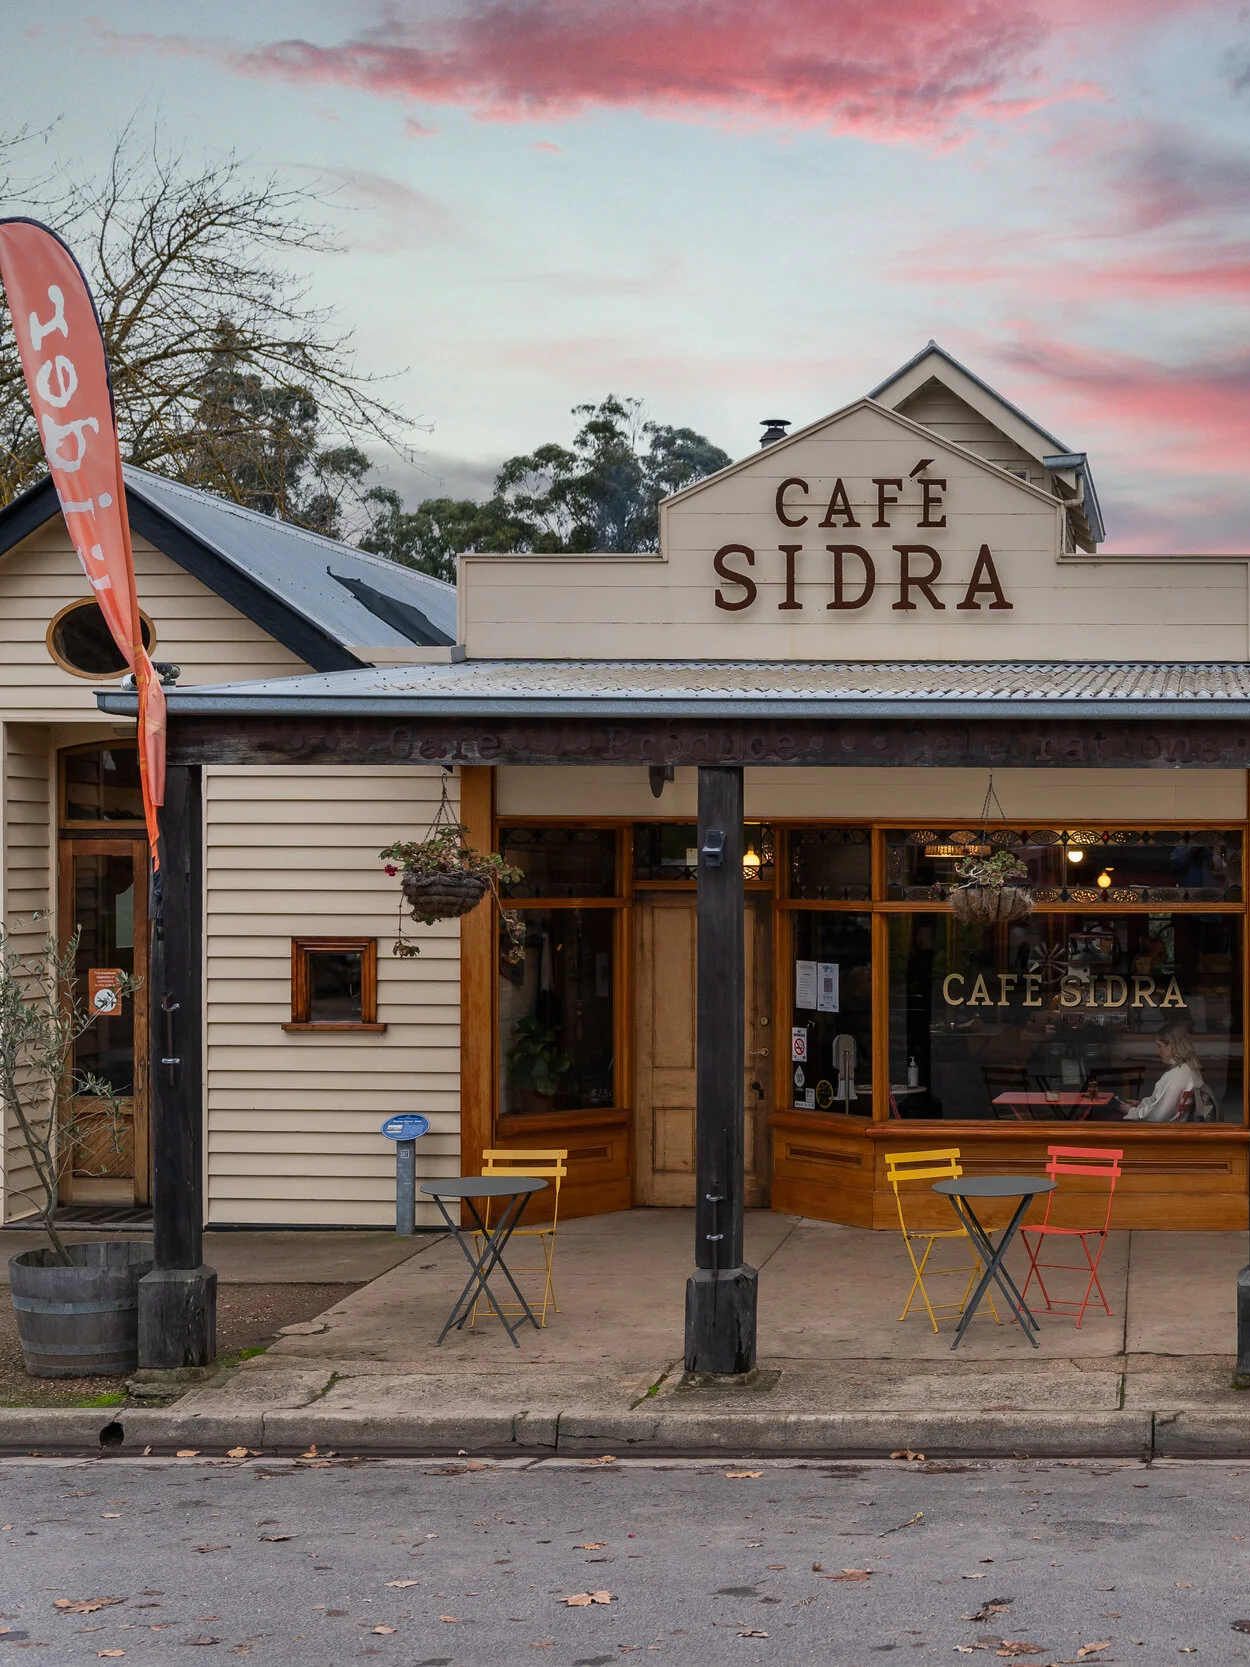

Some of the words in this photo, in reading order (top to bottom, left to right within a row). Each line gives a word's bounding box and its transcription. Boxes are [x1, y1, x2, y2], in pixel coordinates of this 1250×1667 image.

[775, 459, 947, 528] CAFÉ
[714, 543, 1014, 611] SIDRA
[602, 725, 799, 761] Produce
[943, 962, 1043, 1007] CAFÉ
[1060, 974, 1188, 1008] SIDRA
